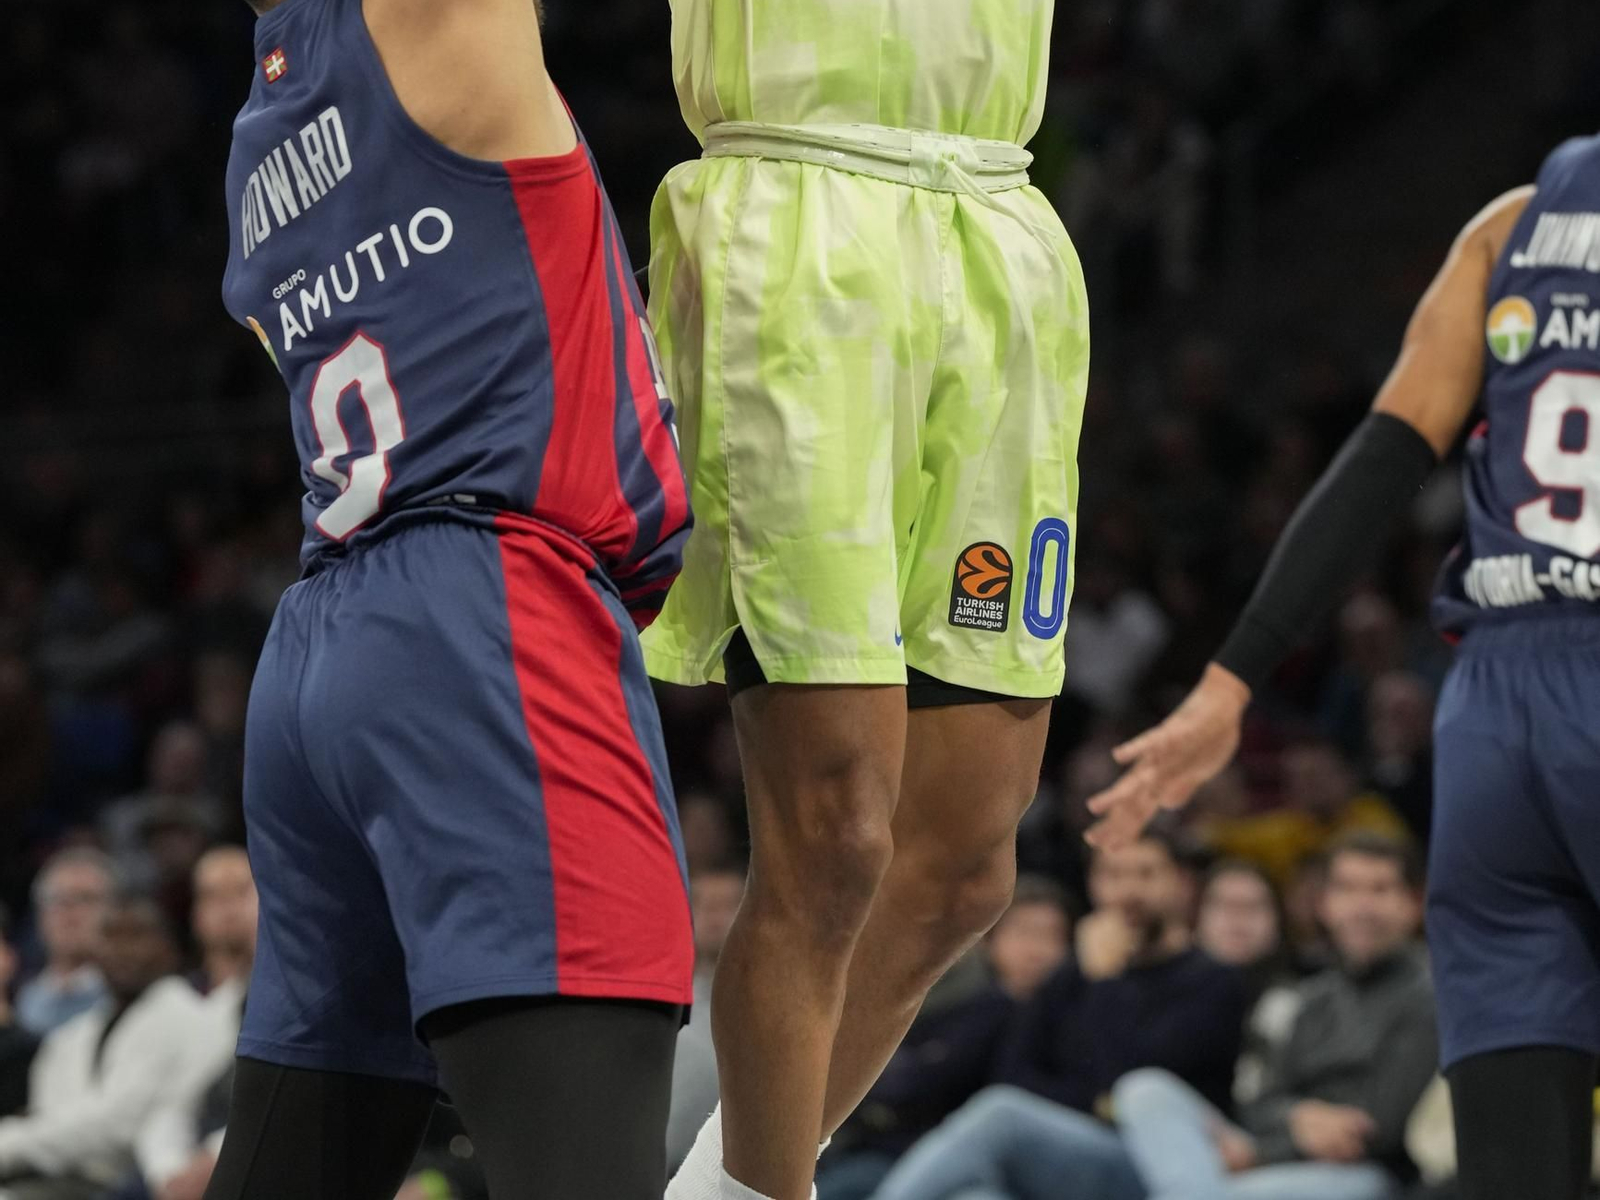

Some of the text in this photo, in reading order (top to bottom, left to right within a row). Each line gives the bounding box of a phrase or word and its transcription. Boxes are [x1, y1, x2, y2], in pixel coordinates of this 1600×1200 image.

[242, 106, 352, 260] HOWARD
[272, 268, 306, 299] GRUPO
[279, 206, 453, 351] AMUTIO
[1513, 369, 1600, 559] 9
[955, 606, 1003, 620] AIRLINES
[957, 597, 1004, 611] TURKISH
[1022, 517, 1070, 640] 0
[953, 615, 1003, 629] EuroLeague
